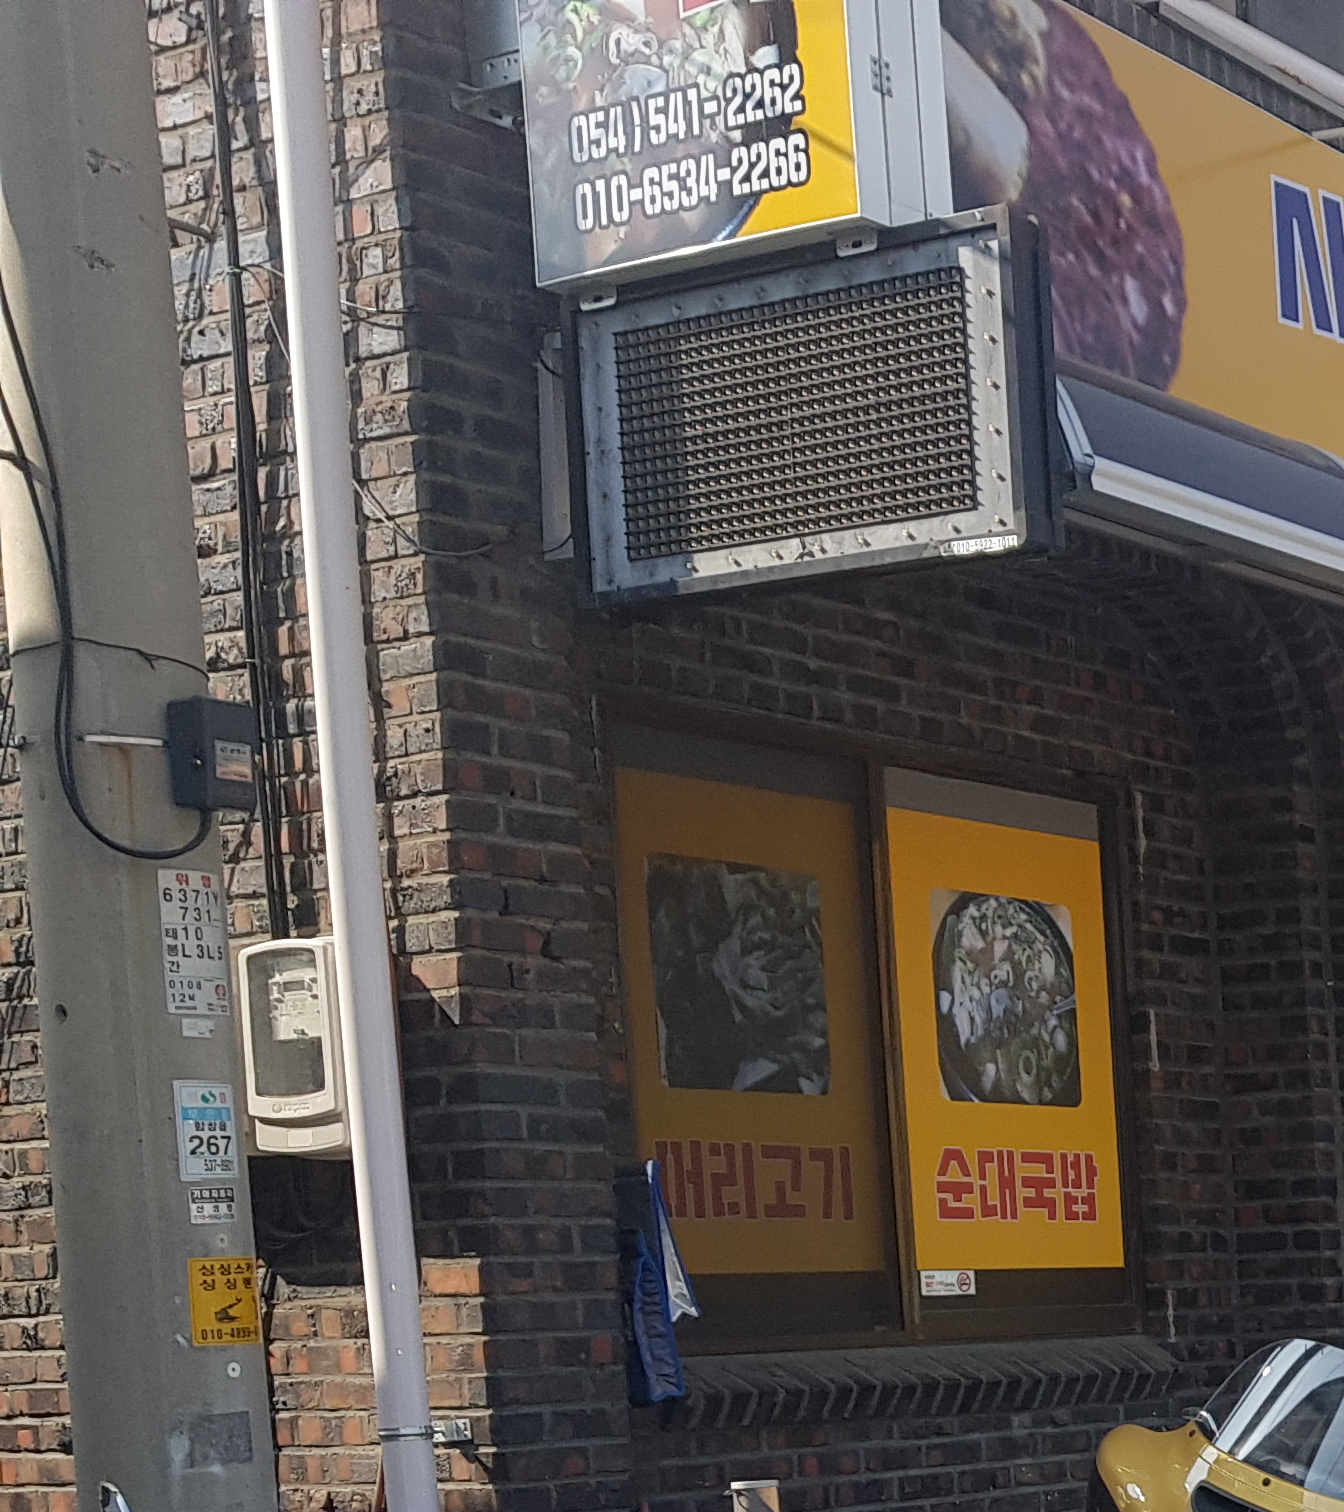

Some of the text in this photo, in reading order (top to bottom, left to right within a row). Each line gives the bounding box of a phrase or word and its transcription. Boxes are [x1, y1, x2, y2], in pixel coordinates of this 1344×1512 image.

[574, 133, 811, 232] 010-6534-2266
[188, 1134, 233, 1156] 267
[935, 1144, 1099, 1222] 순대국밥
